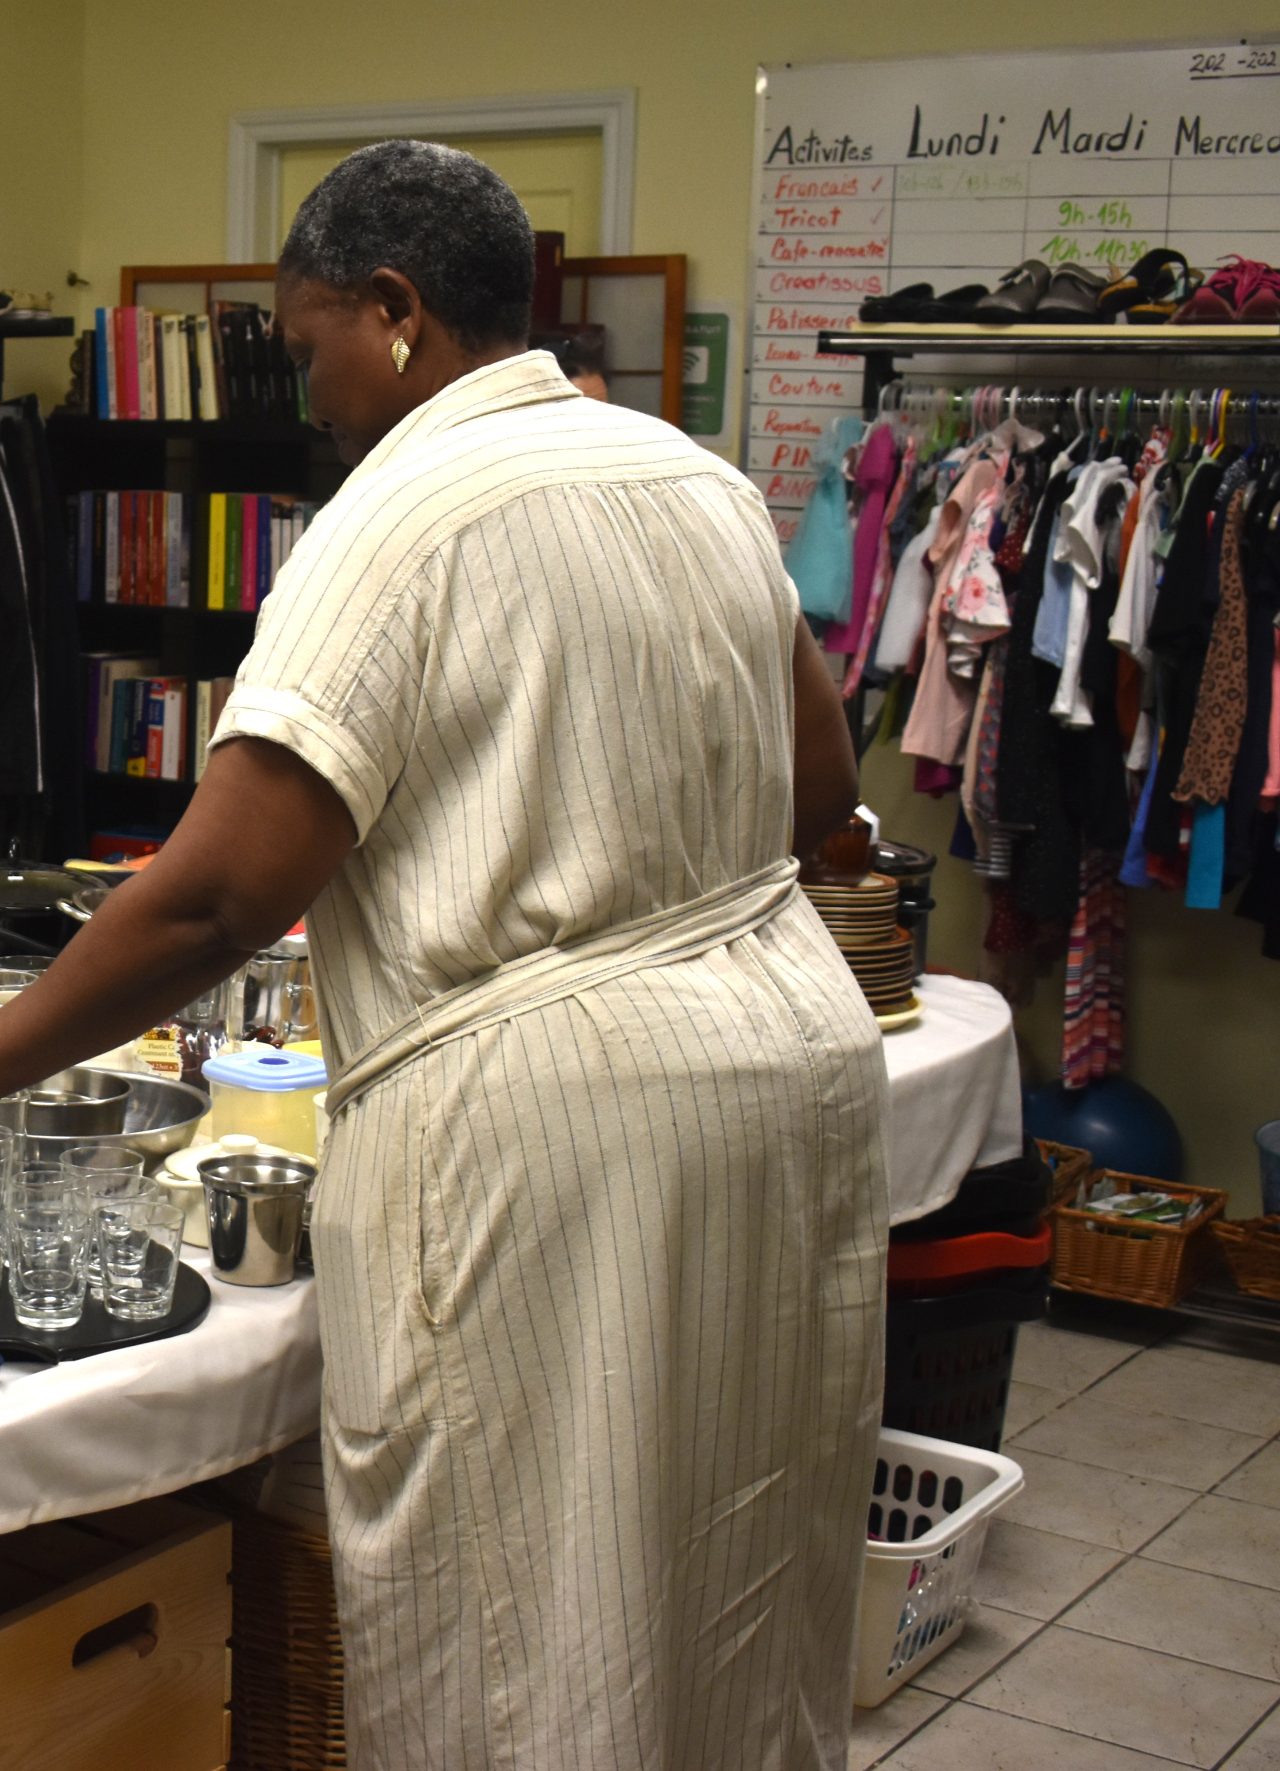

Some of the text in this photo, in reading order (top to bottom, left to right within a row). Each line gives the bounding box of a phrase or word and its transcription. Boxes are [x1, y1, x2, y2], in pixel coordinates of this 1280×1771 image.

[765, 126, 873, 165] Activites
[907, 104, 1006, 158] Lundi
[1032, 107, 1148, 155] Mardi
[774, 206, 842, 228] Tricot
[768, 373, 844, 396] Couture
